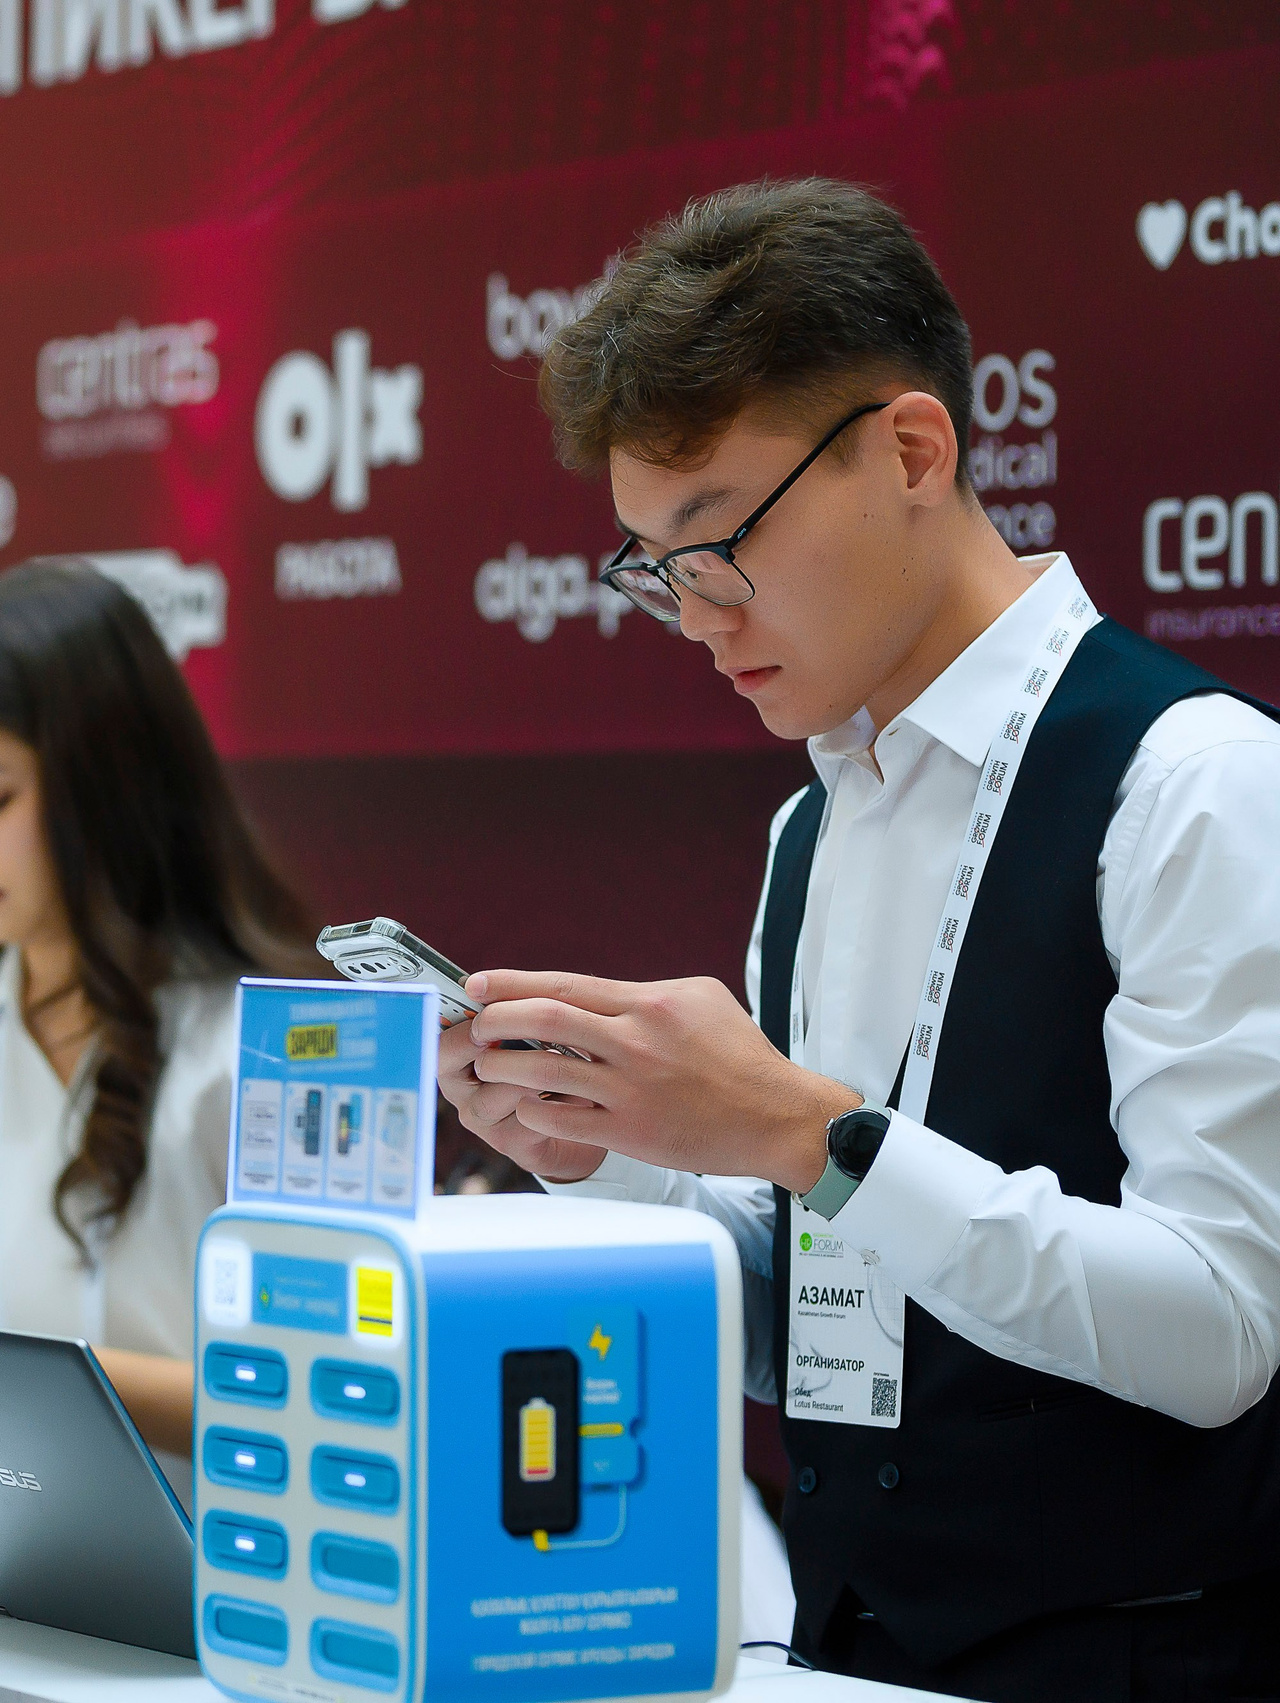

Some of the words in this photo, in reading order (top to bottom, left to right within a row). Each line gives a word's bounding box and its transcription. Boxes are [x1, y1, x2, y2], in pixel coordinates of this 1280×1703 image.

[968, 429, 1058, 492] dical
[1030, 669, 1049, 697] FORUM
[1003, 711, 1020, 740] GROWTH
[1010, 712, 1028, 743] FORUM
[986, 760, 1001, 791] GROWTH
[992, 761, 1009, 795] FORUM
[970, 812, 985, 844] GROWTH
[976, 814, 992, 847] FORUM
[955, 865, 969, 896] GROWTH
[960, 866, 975, 900] FORUM
[940, 917, 953, 949] GROWTH
[945, 919, 960, 952] FORUM
[927, 970, 939, 1002] GROWTH
[932, 972, 946, 1006] FORUM
[915, 1024, 927, 1056] GROWTH
[921, 1025, 934, 1060] FORUM
[813, 1239, 844, 1251] FORUM
[798, 1285, 865, 1309] АЗАМАТ
[796, 1355, 865, 1372] ОРГАНИЗАТОР
[794, 1400, 811, 1409] Lotus
[812, 1402, 844, 1412] Restaurant
